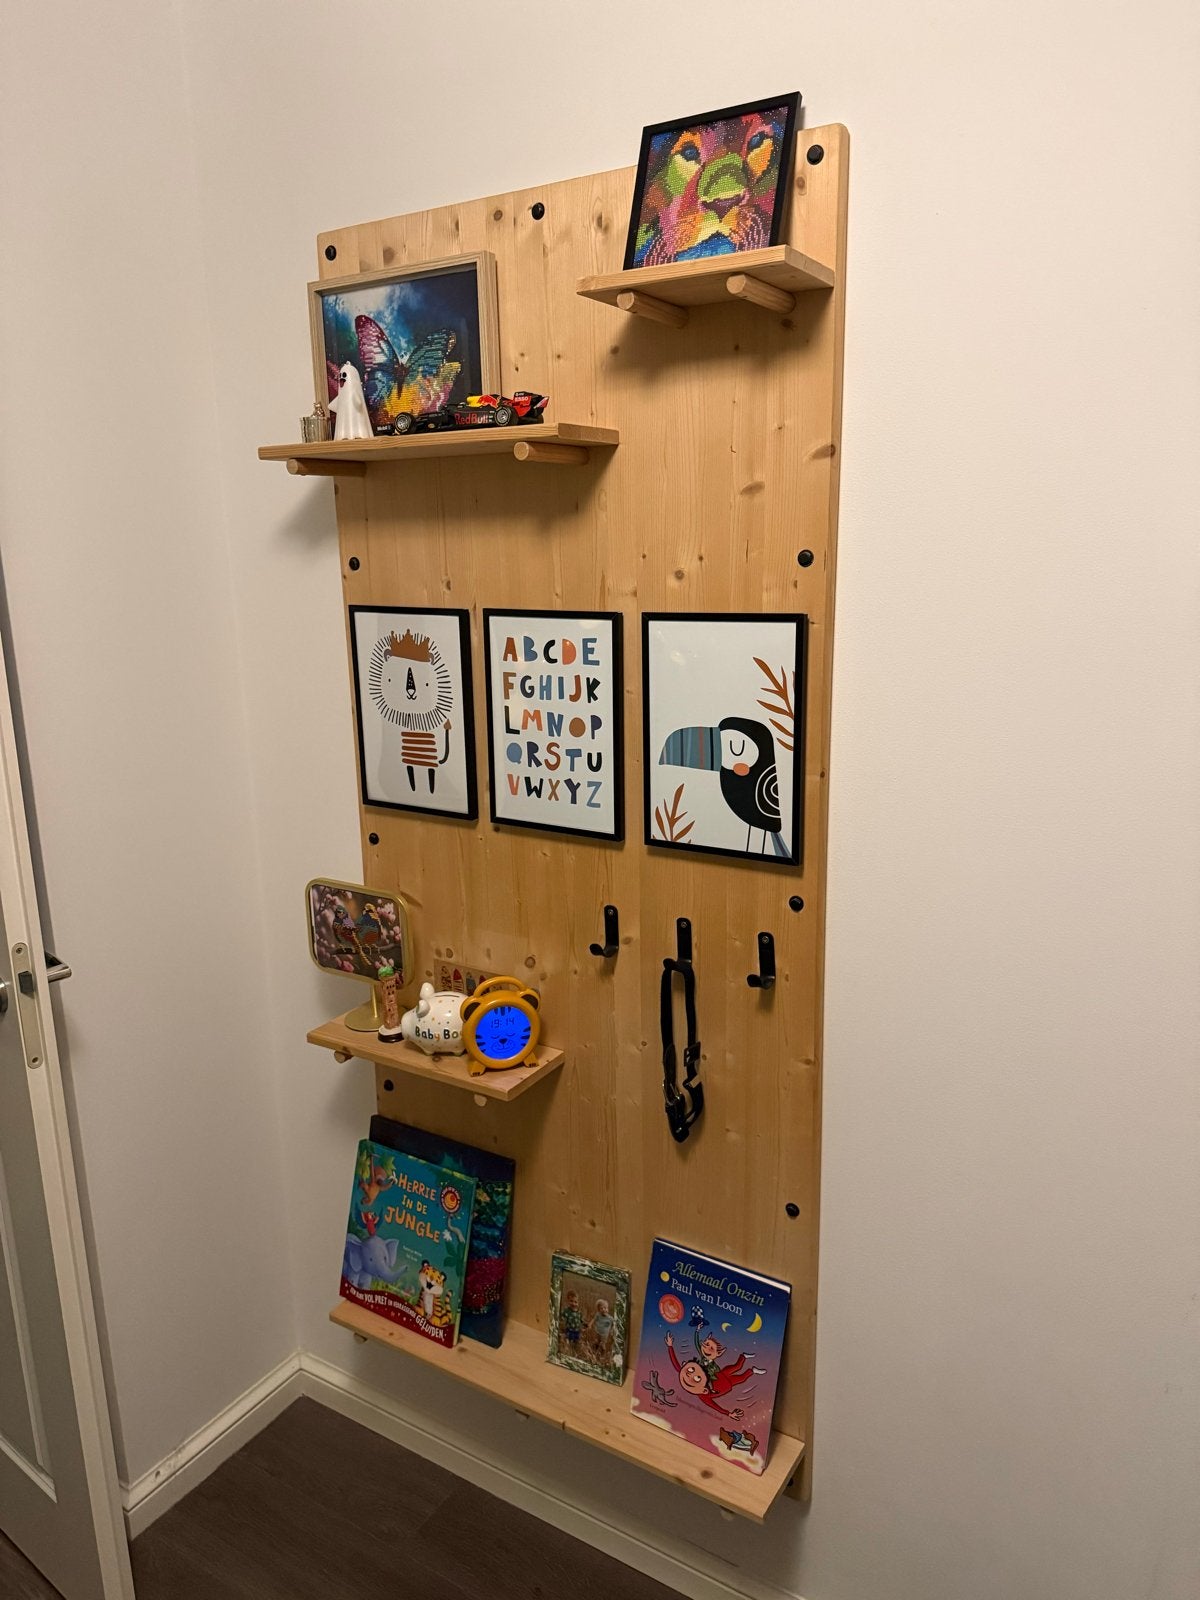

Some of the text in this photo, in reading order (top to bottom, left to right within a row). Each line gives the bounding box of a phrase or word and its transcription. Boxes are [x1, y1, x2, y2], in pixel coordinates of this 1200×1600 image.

[454, 413, 488, 424] Red Bull
[415, 1025, 440, 1041] Baby
[398, 1173, 436, 1201] HERRIE
[401, 1194, 427, 1215] IN DE
[384, 1206, 440, 1243] JUNGLE
[672, 1261, 764, 1306] Allemaal Onzin
[365, 1293, 374, 1303] VOL
[375, 1295, 387, 1305] PRET
[671, 1278, 743, 1315] Paul van Loon
